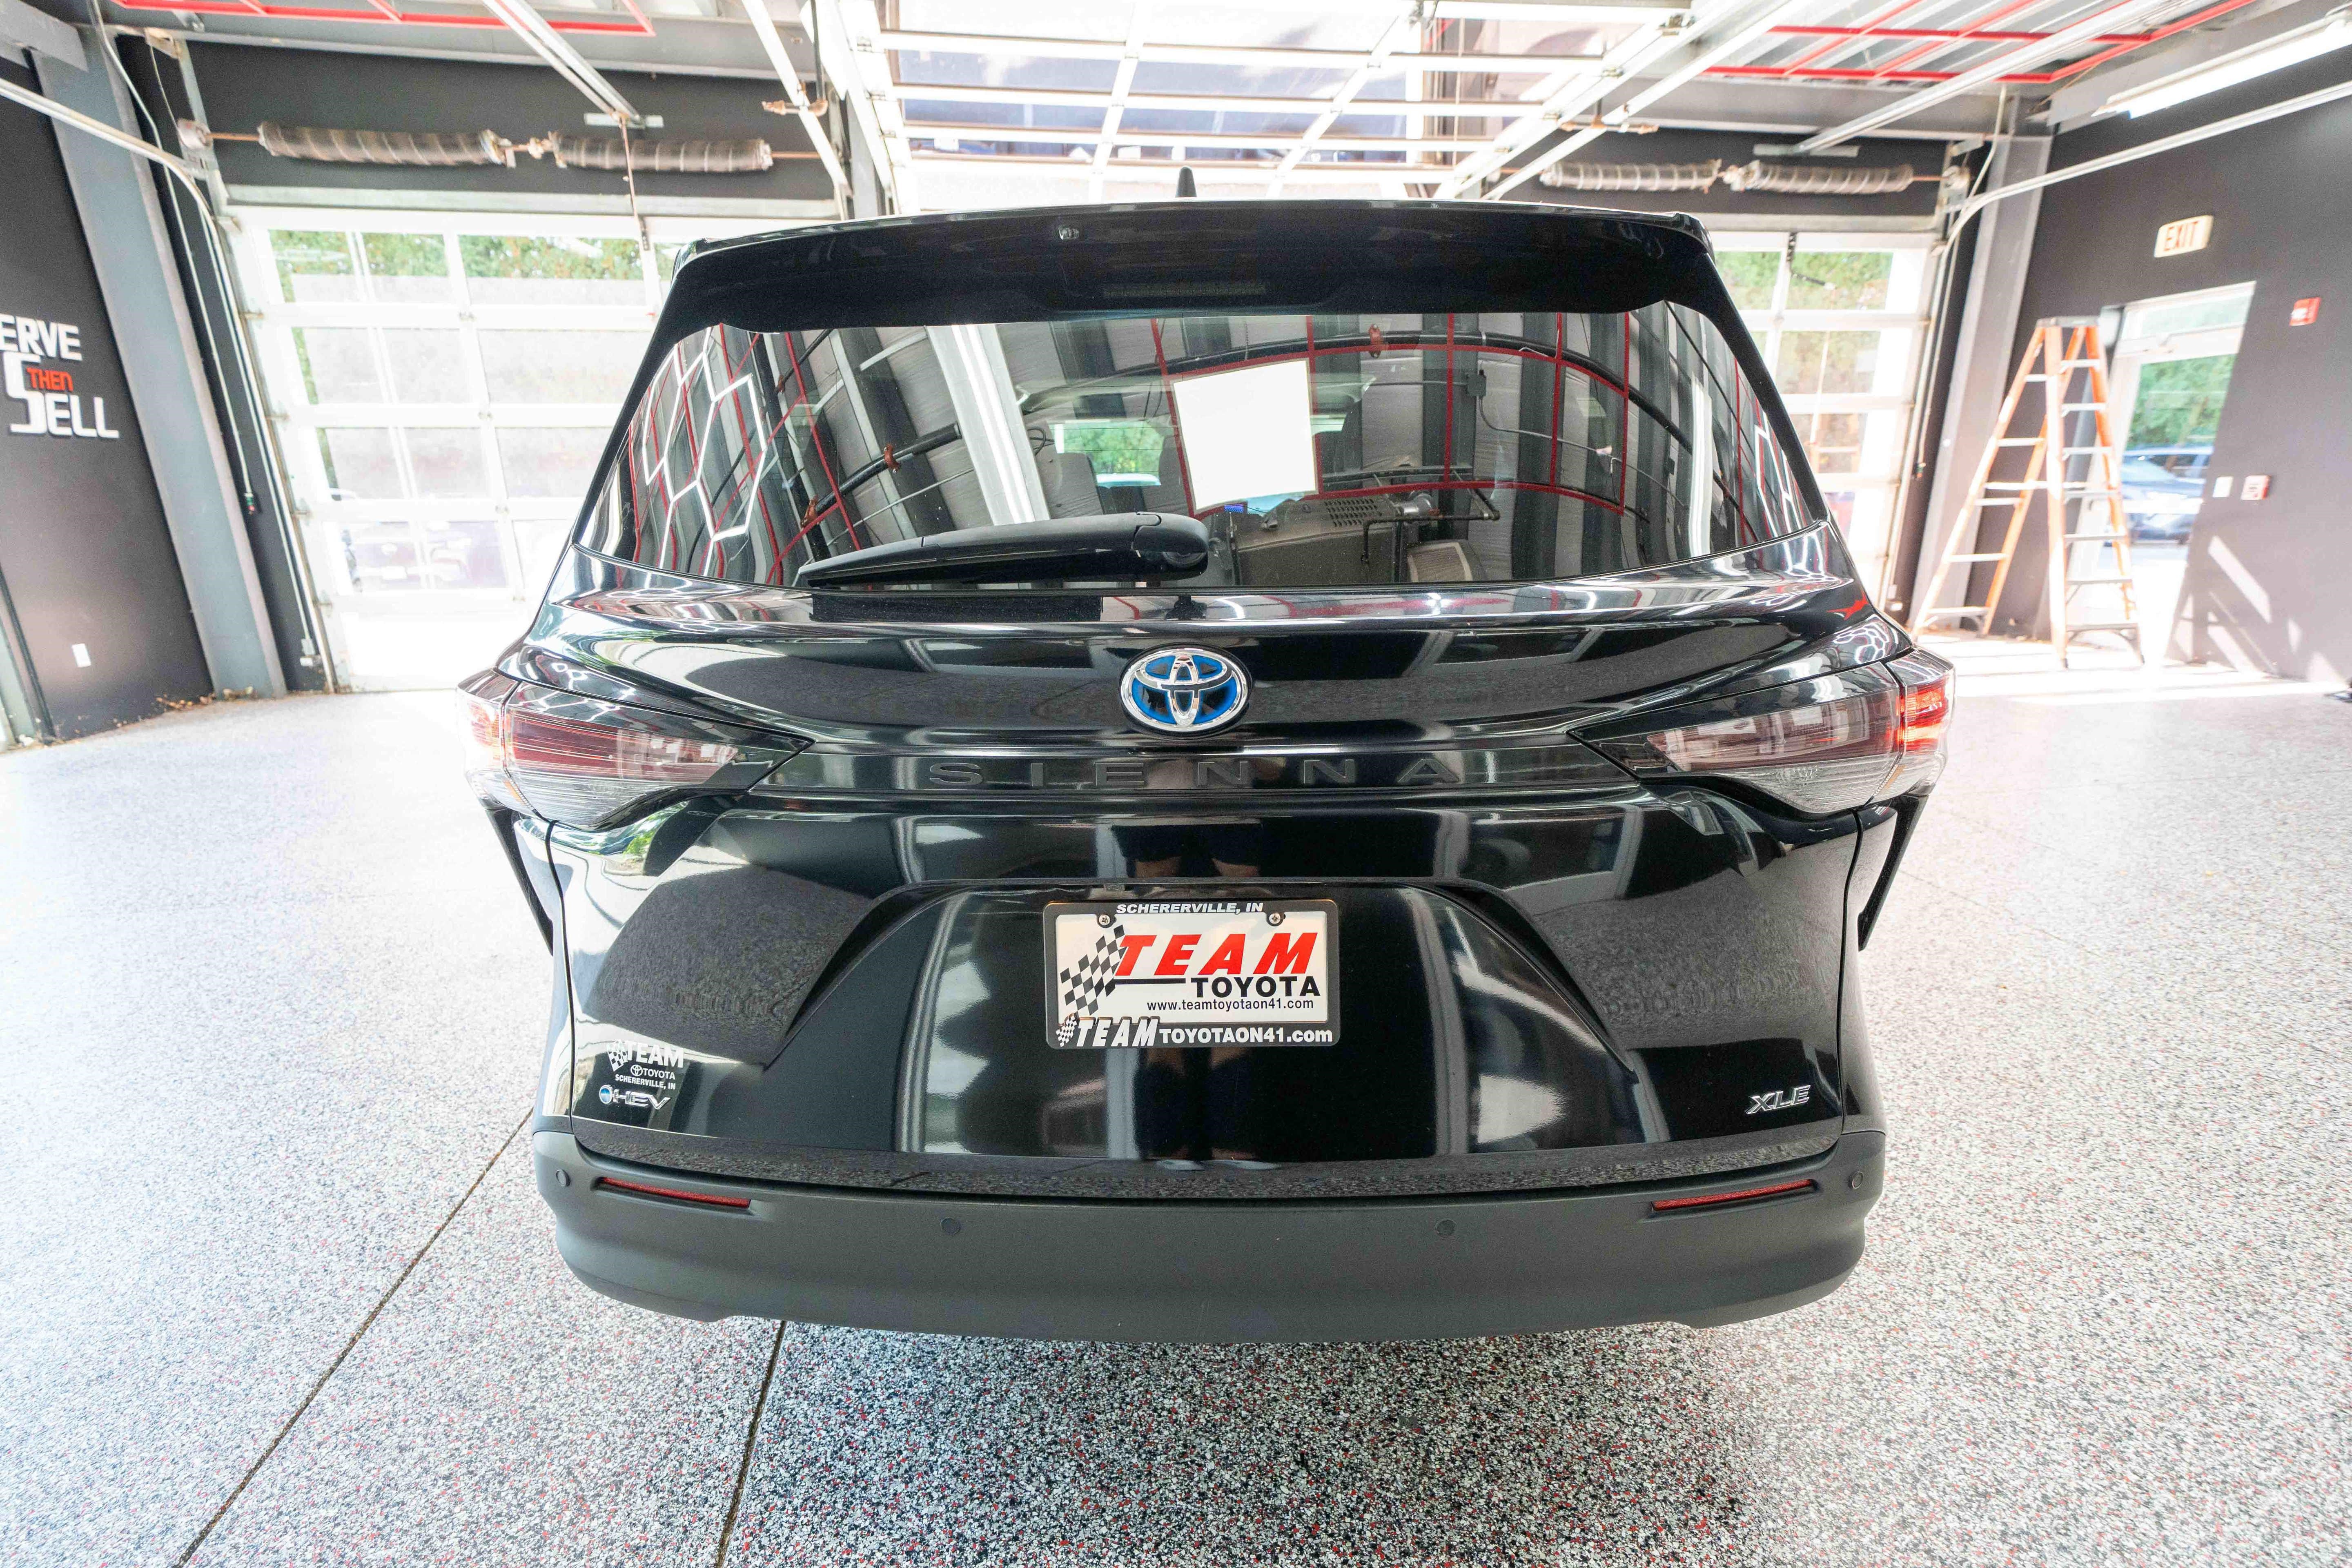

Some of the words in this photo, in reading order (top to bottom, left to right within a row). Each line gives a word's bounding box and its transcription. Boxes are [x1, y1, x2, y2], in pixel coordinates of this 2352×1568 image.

[2164, 221, 2199, 252] EXIT
[27, 367, 74, 391] THEN
[3, 352, 120, 439] SELL
[929, 759, 1460, 786] SIENNA
[1116, 904, 1241, 914] SCHERERVILLE,
[1245, 903, 1263, 912] IN
[1115, 933, 1318, 976] TEAM
[1191, 976, 1321, 998] TOYOTA
[1147, 999, 1314, 1012] www.teamtoyotaon41.com
[1076, 1020, 1159, 1047] TEAM
[1159, 1027, 1333, 1044] TOYOTAON41.com
[625, 1040, 684, 1068] TEAM
[615, 1074, 666, 1090] SCHERERVILLE,
[643, 1068, 675, 1080] TOYOTA
[1745, 1085, 1811, 1114] XLE
